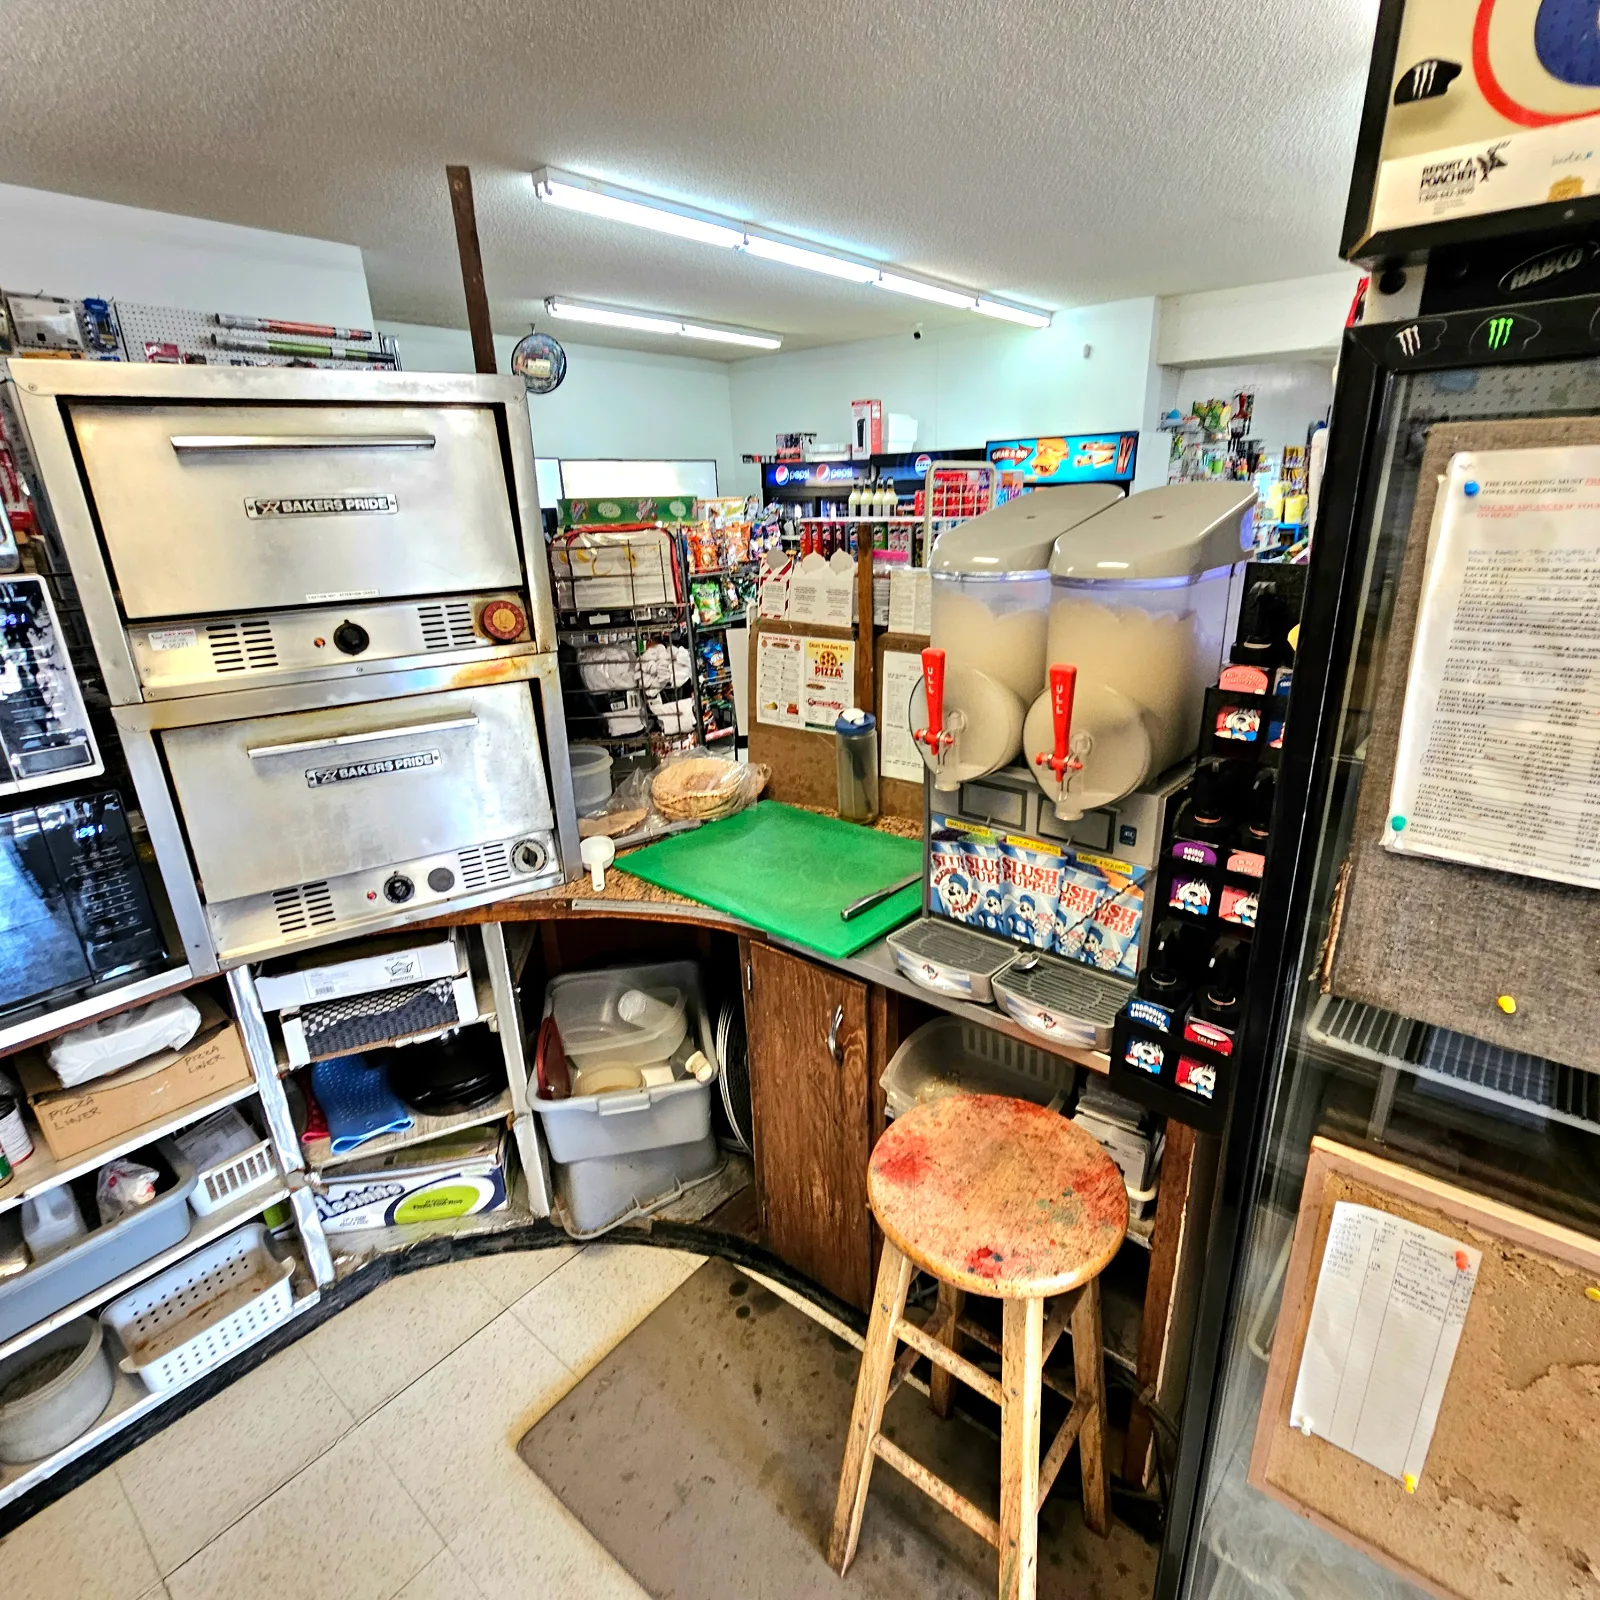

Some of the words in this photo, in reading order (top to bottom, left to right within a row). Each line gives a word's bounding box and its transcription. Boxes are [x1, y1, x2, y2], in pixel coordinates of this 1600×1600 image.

[1422, 159, 1463, 176] REPORT
[1465, 157, 1472, 169] A
[1420, 168, 1477, 188] POACHER
[789, 469, 810, 481] pepsi
[831, 467, 853, 479] pepsi
[281, 498, 344, 513] BAKERS
[345, 497, 389, 511] PRIDE
[814, 665, 842, 678] PIZZA
[338, 759, 393, 780] BAKERS
[393, 753, 433, 770] PRIDE
[1002, 856, 1060, 885] SLUSH
[1078, 854, 1098, 864] LARGE
[1104, 861, 1131, 872] SQUIRTS
[184, 1045, 220, 1067] PIZZA
[187, 1055, 226, 1075] LINER
[48, 1096, 95, 1121] PIZZA
[53, 1106, 103, 1131] LINER
